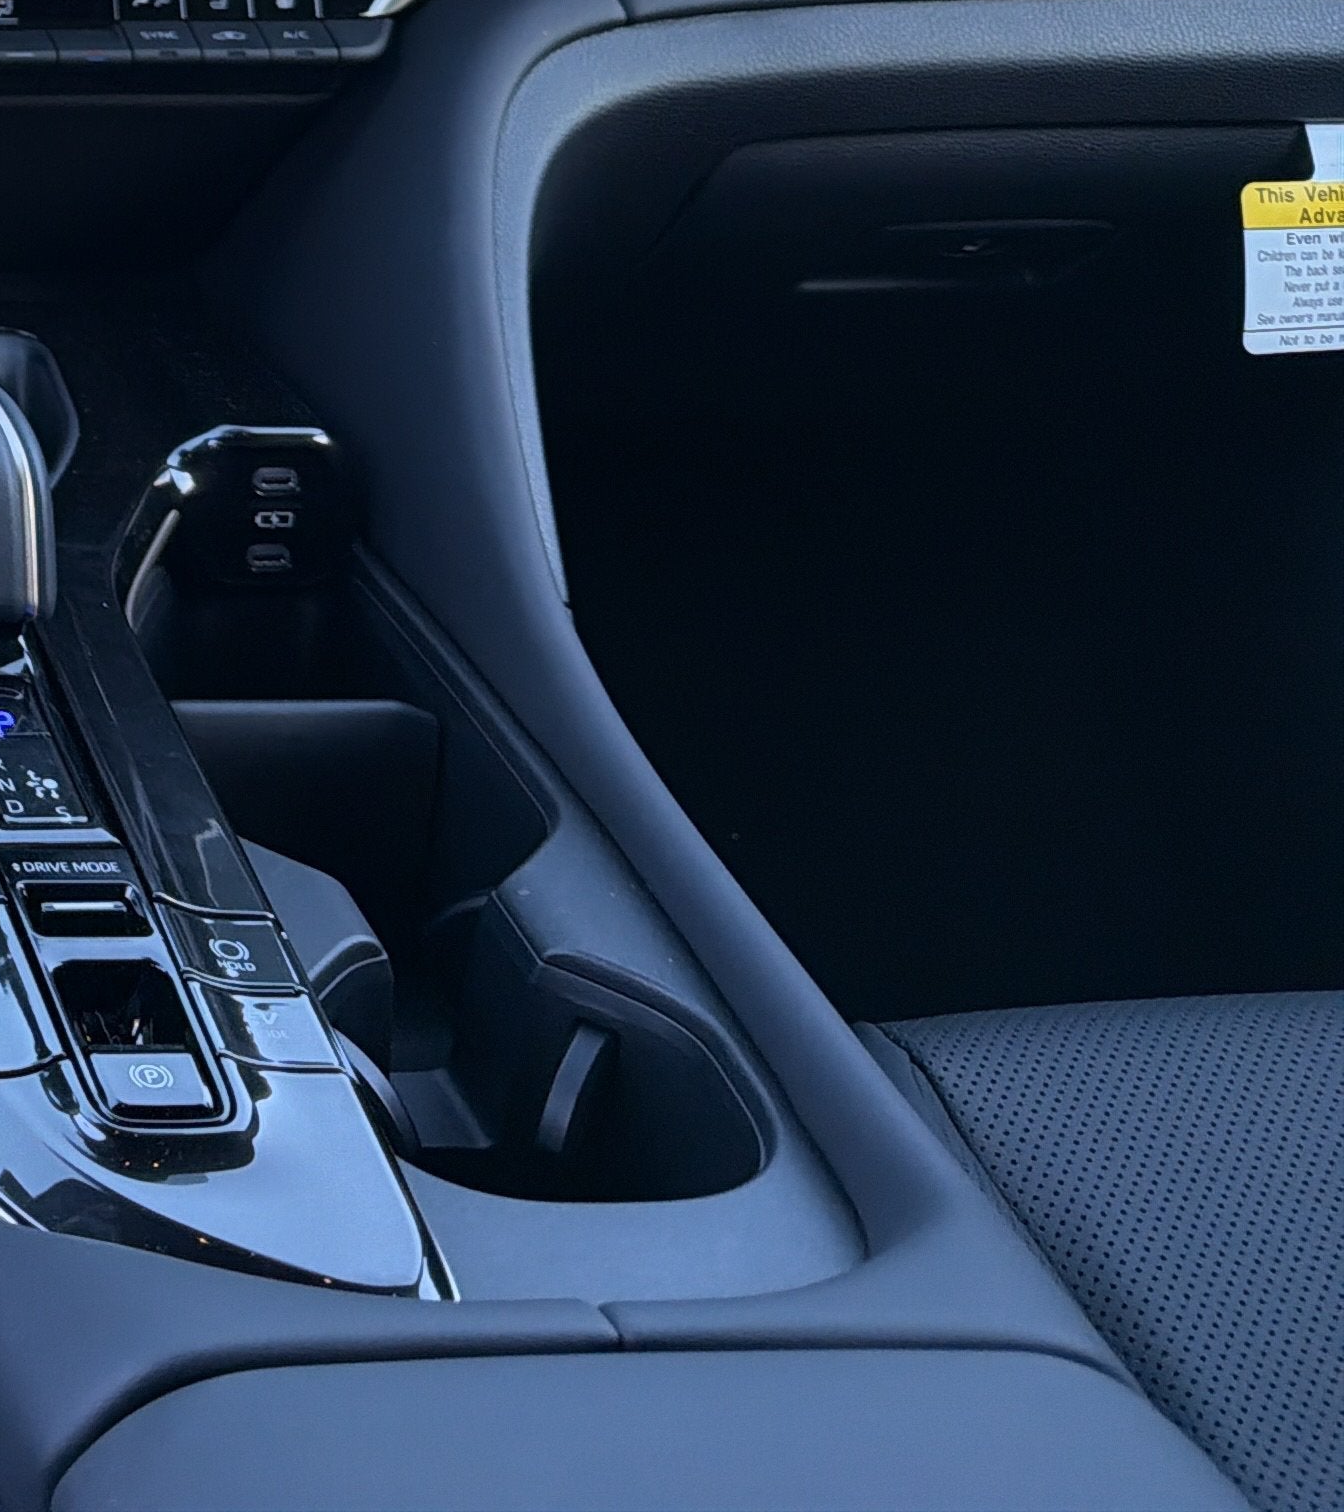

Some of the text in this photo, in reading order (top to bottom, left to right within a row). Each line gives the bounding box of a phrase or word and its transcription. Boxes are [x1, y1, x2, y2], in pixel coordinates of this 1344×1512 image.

[1254, 187, 1295, 204] This
[1286, 232, 1321, 246] Even
[1257, 249, 1296, 262] Children
[1300, 251, 1318, 261] can
[1322, 249, 1334, 261] be
[1284, 265, 1303, 277] The
[1306, 264, 1328, 276] back
[1284, 281, 1340, 294] Never put a
[1292, 296, 1343, 310] Always use
[1256, 313, 1275, 325] See
[1278, 313, 1313, 324] owner's
[1279, 335, 1299, 346] Not
[1304, 335, 1315, 345] to
[1320, 333, 1334, 345] be
[5, 799, 24, 814] D
[55, 806, 72, 824] S
[23, 862, 121, 873] DRIVE MODE
[216, 959, 257, 972] HOLD
